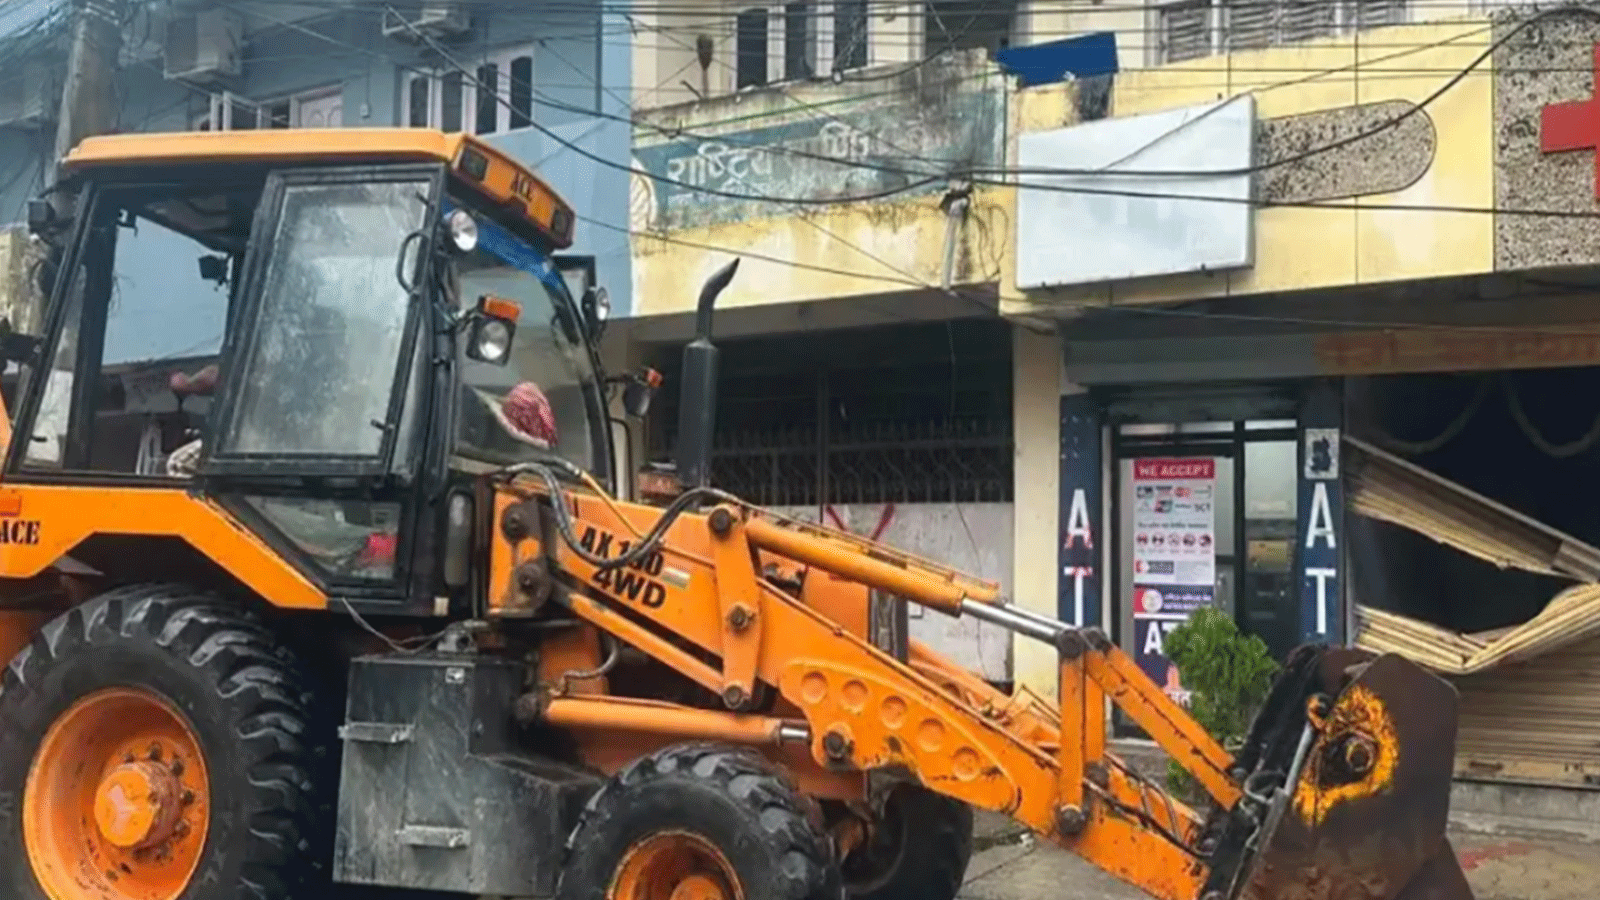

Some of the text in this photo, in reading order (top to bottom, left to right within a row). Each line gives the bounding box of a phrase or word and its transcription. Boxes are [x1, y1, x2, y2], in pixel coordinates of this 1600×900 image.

[1139, 464, 1210, 477] WE ACCEPT
[0, 519, 41, 545] ACE
[580, 526, 613, 560] AX
[592, 566, 667, 608] 4WD
